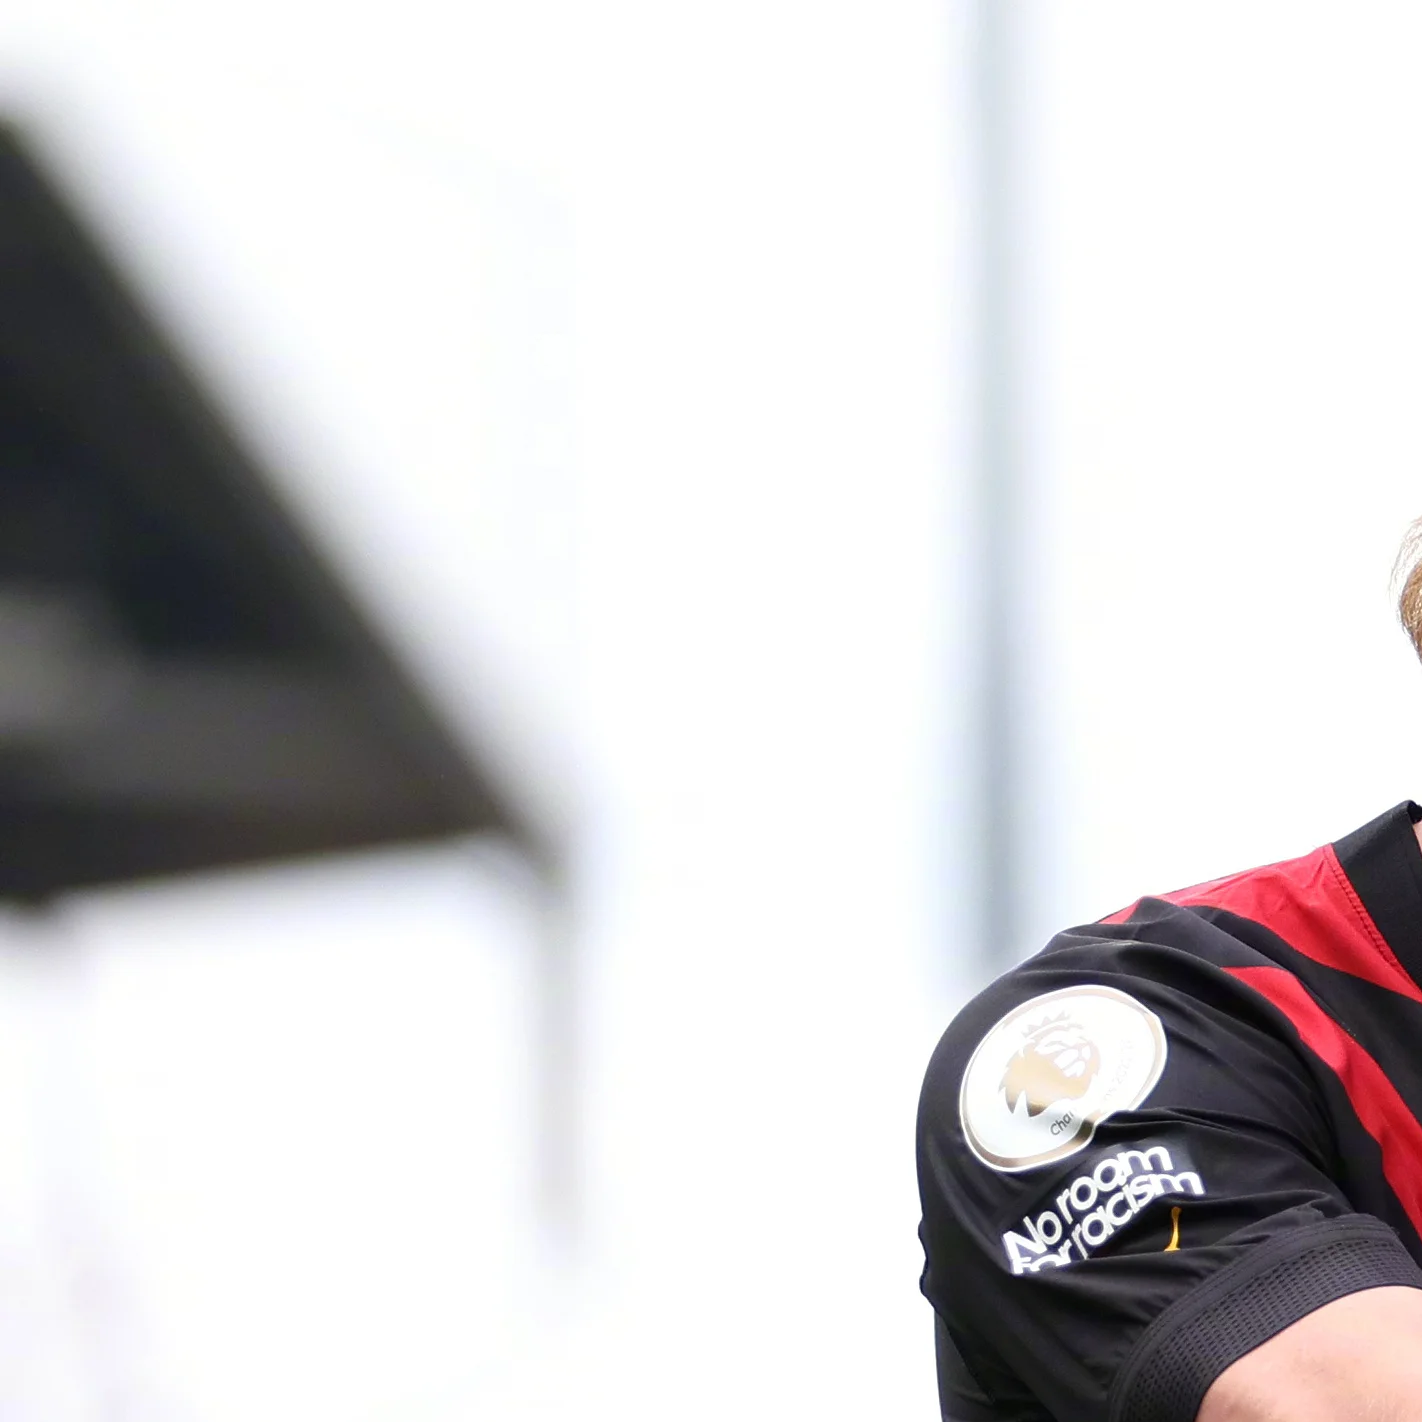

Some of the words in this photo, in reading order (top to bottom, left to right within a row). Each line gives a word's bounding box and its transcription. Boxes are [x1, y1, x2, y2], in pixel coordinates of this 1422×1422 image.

[1003, 1214, 1062, 1257] No
[1056, 1145, 1174, 1224] room
[1070, 1172, 1206, 1258] racism
